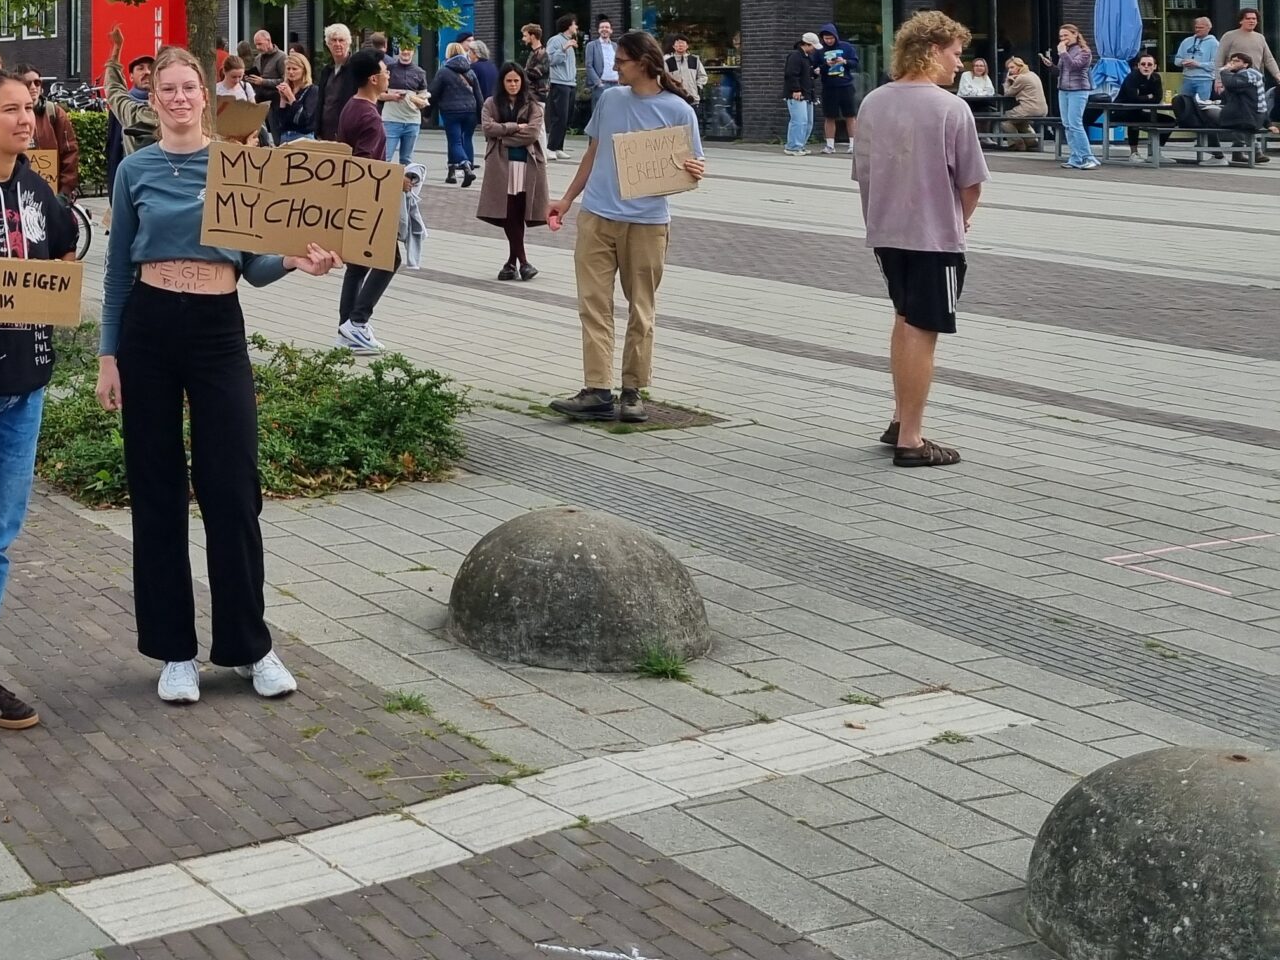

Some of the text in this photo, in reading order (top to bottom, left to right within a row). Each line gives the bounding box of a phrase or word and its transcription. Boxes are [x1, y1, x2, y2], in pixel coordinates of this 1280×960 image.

[644, 135, 676, 151] AWAY
[220, 150, 392, 202] MY BODY
[626, 156, 677, 185] CREEPS
[216, 191, 384, 258] MY CHOICE!
[2, 270, 18, 287] IN
[22, 272, 71, 292] EIGEN
[34, 341, 51, 353] FUL
[34, 354, 51, 366] FUL
